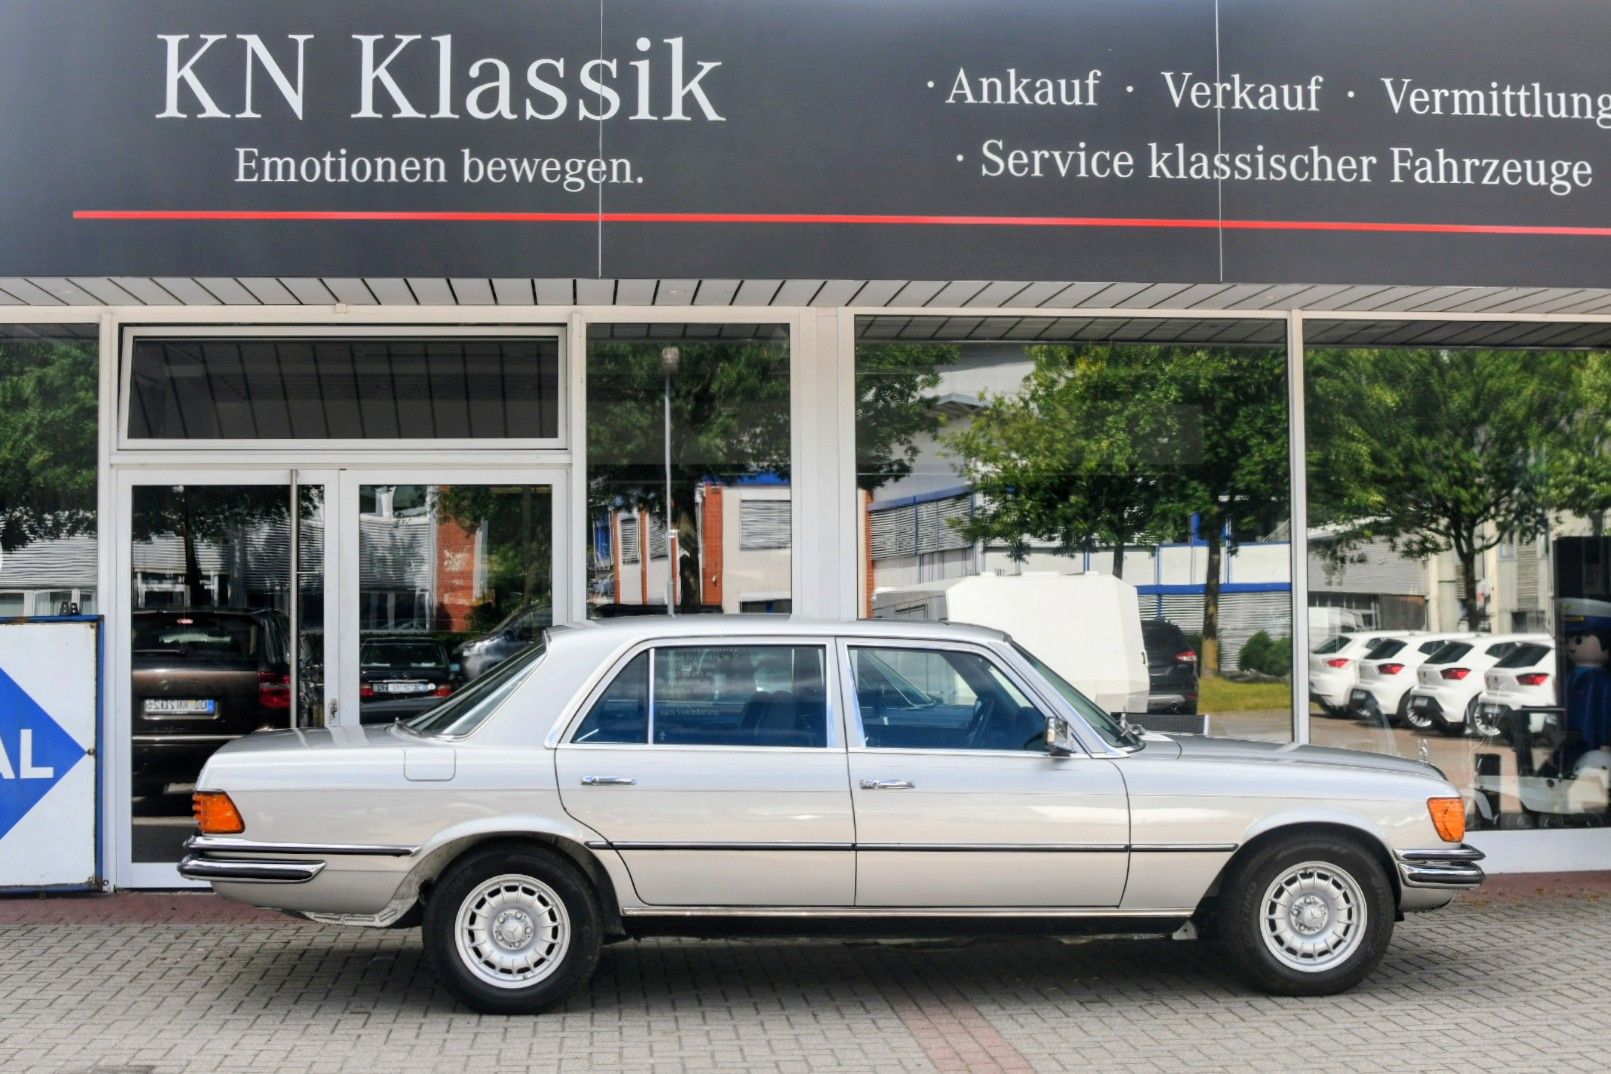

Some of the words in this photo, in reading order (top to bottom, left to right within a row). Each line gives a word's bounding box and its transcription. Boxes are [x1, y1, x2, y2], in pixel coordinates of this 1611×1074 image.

[155, 33, 315, 121] KN
[350, 33, 727, 122] Klassik
[945, 67, 1102, 106] Ankauf
[1160, 71, 1323, 112] Verkauf
[1380, 77, 1611, 130] Vermittlung
[234, 147, 447, 183] Emotionen
[461, 148, 644, 193] bewegen.
[981, 139, 1134, 178] Service
[1148, 142, 1377, 183] klassischer
[1389, 147, 1593, 196] Fahrzeuge
